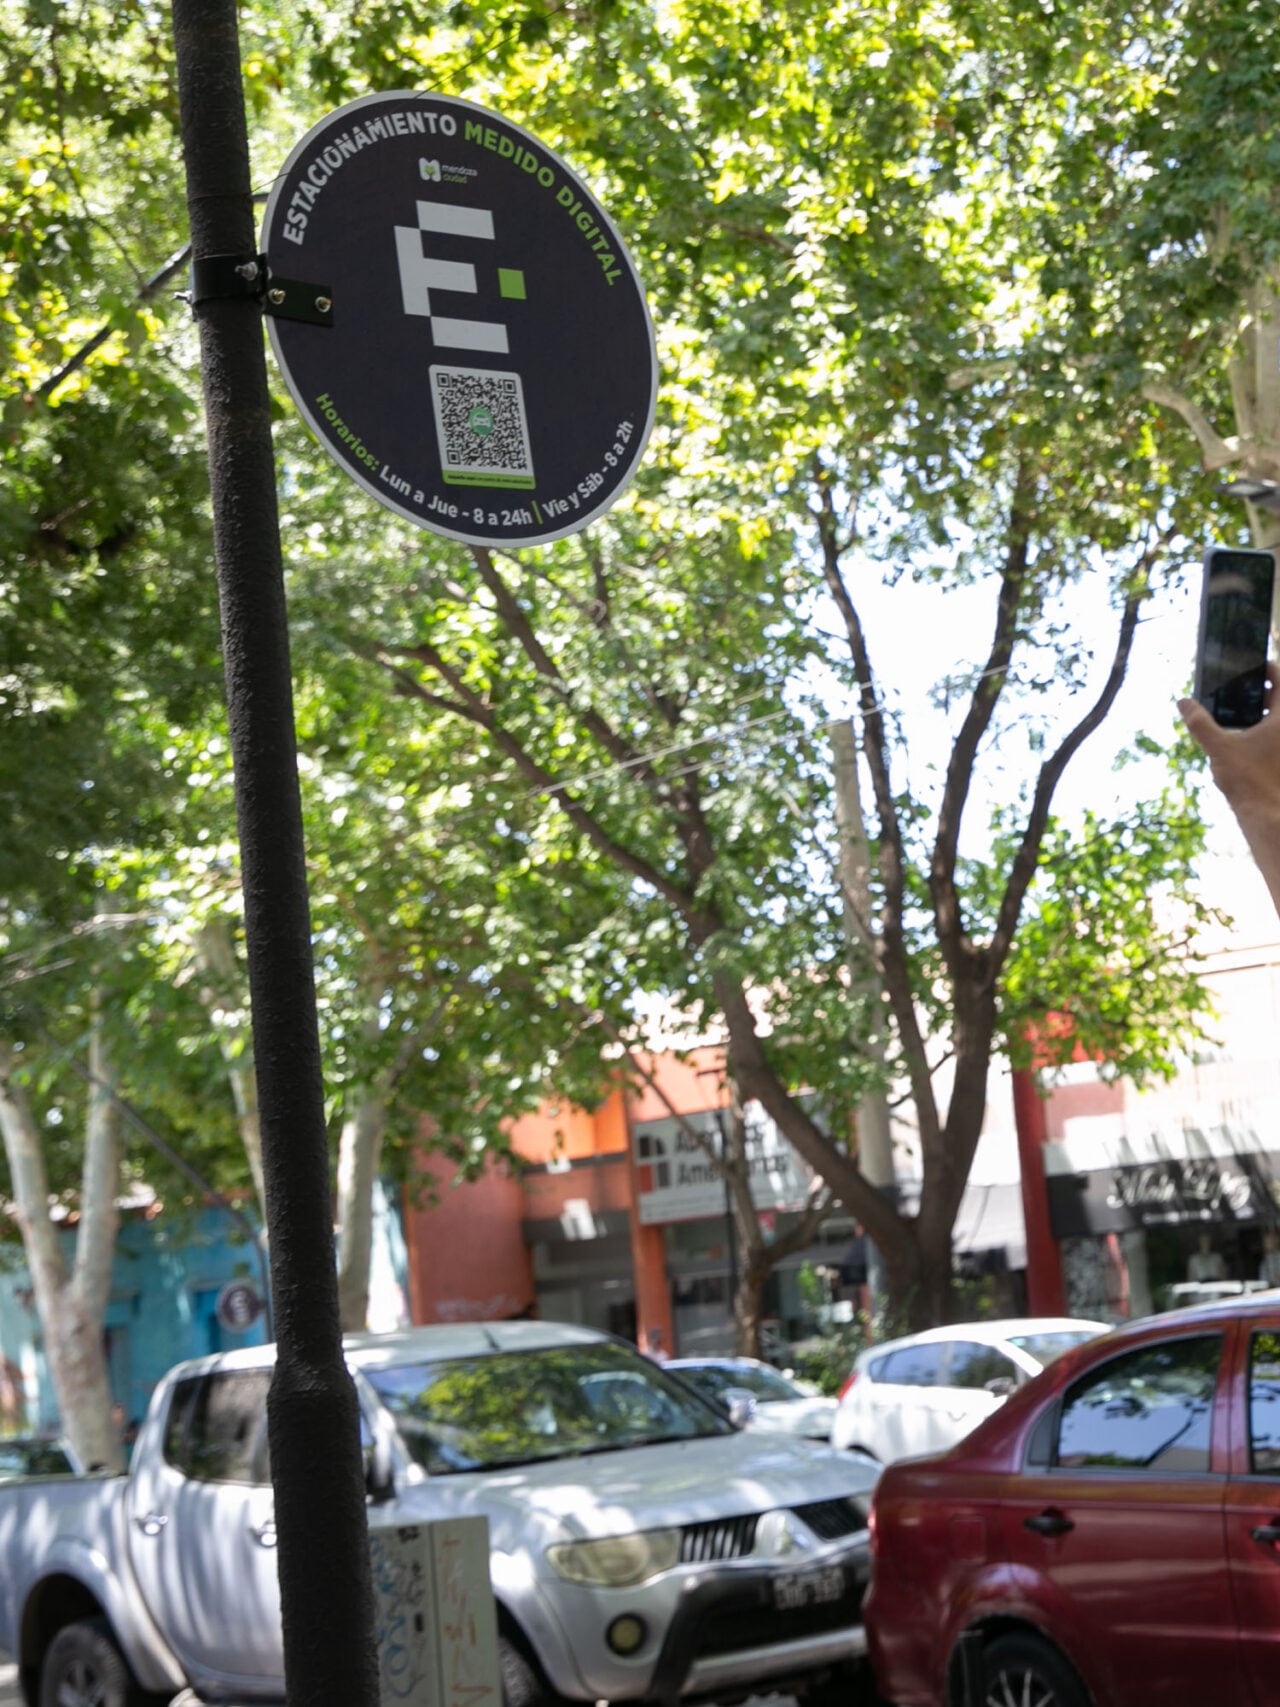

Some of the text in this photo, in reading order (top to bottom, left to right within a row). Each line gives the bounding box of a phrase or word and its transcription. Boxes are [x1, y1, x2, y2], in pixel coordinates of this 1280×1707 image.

[283, 112, 623, 286] ESTACIONAMIENTO MEDIDO DIGITAL
[315, 392, 380, 472] Horarios:
[616, 420, 634, 444] 2h
[613, 443, 625, 455] a
[604, 452, 618, 467] 8
[379, 465, 412, 496] Lun
[577, 472, 604, 499] Sáb
[413, 490, 425, 504] a
[568, 491, 582, 509] y
[427, 495, 459, 518] Jue
[542, 499, 570, 518] Vie
[473, 508, 484, 524] 8
[487, 513, 498, 526] a
[501, 508, 533, 526] 24h
